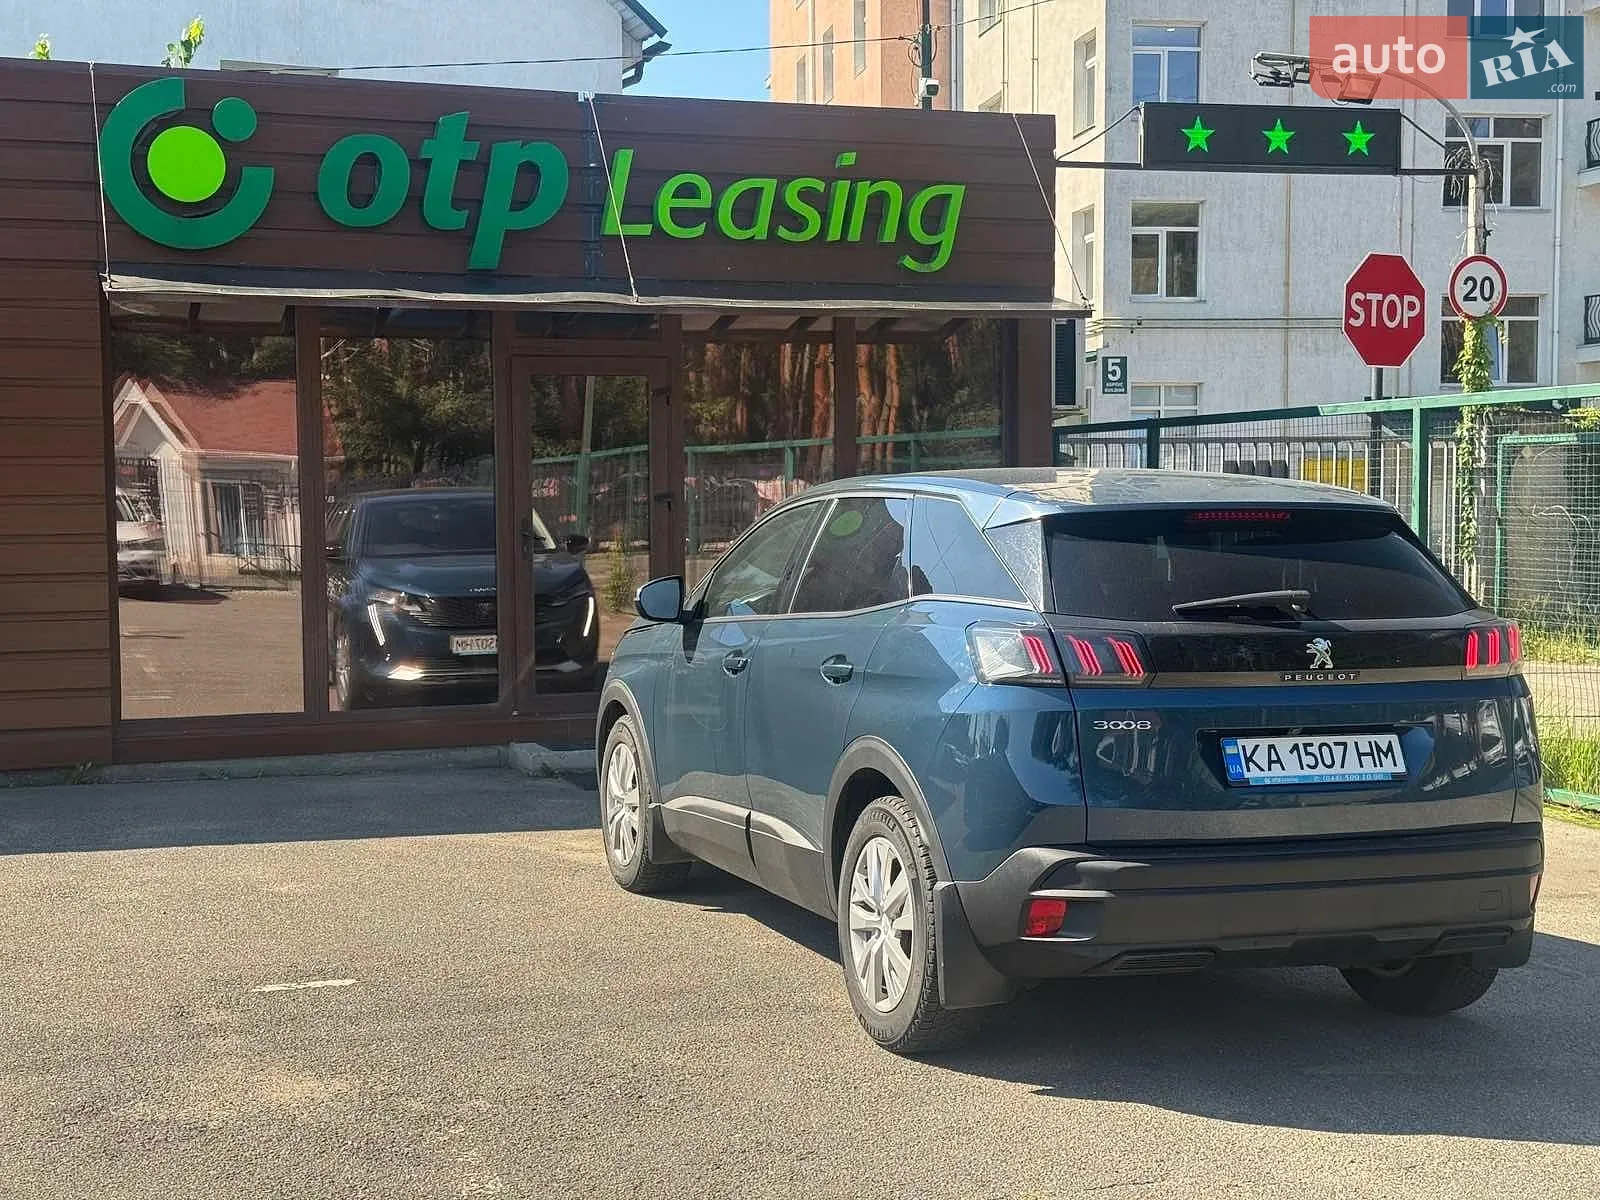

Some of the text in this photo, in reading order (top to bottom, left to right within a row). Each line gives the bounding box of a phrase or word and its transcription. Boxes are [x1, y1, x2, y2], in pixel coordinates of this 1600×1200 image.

[317, 110, 966, 272] otp Leasing
[1462, 275, 1495, 302] 20
[1348, 291, 1421, 329] STOP
[1107, 358, 1121, 382] 5
[1284, 673, 1356, 681] PEUGEOT
[1093, 720, 1151, 730] 3008
[1241, 740, 1398, 772] KA 1507 HM
[1229, 764, 1242, 774] UA
